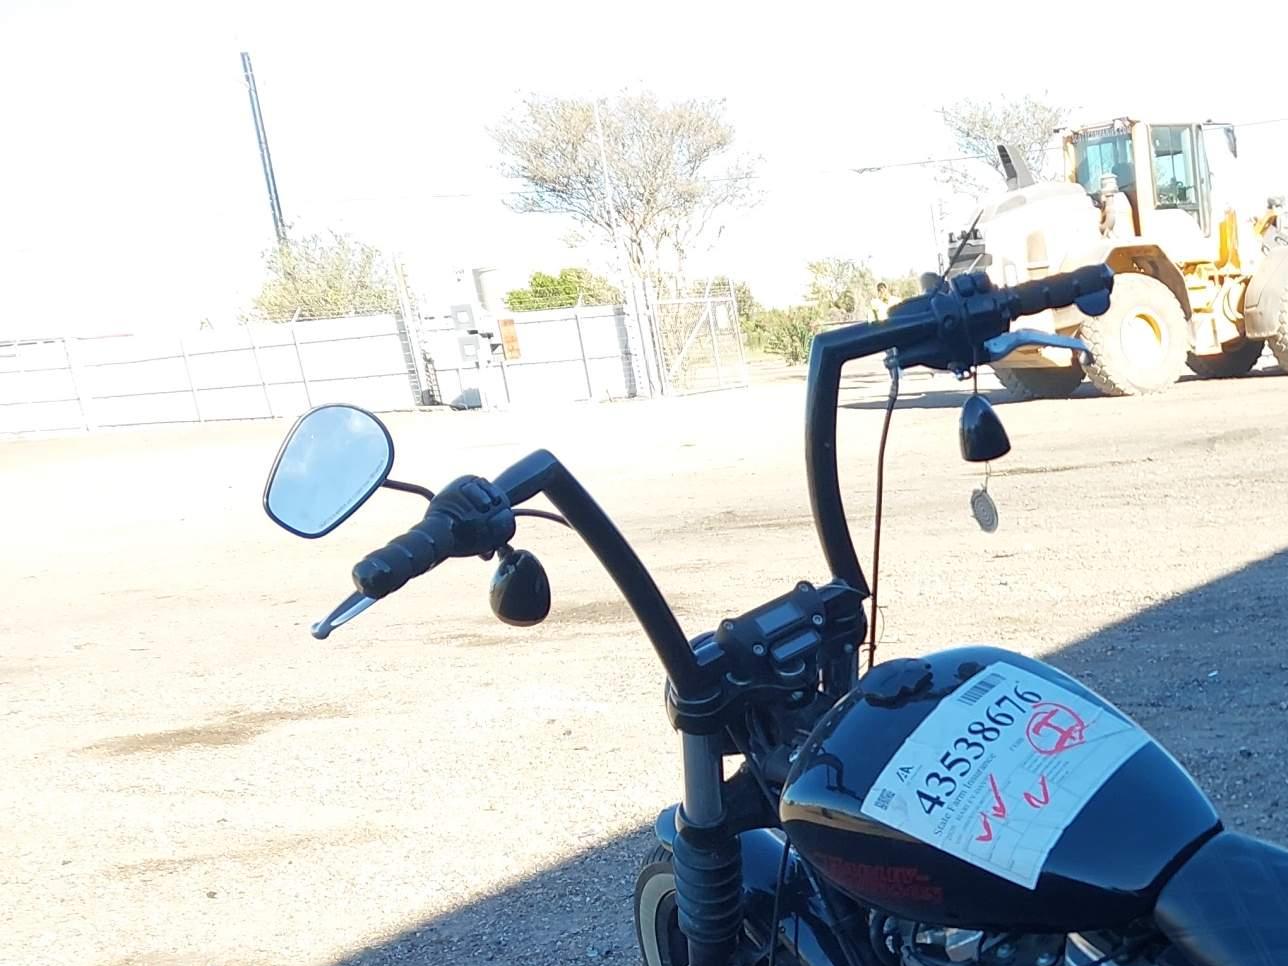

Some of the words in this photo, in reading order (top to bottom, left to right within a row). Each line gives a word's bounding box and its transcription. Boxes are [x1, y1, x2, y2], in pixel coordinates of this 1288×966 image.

[916, 685, 1043, 815] 43538676
[933, 812, 952, 836] State
[946, 788, 969, 813] Farm
[962, 752, 997, 789] Insurance
